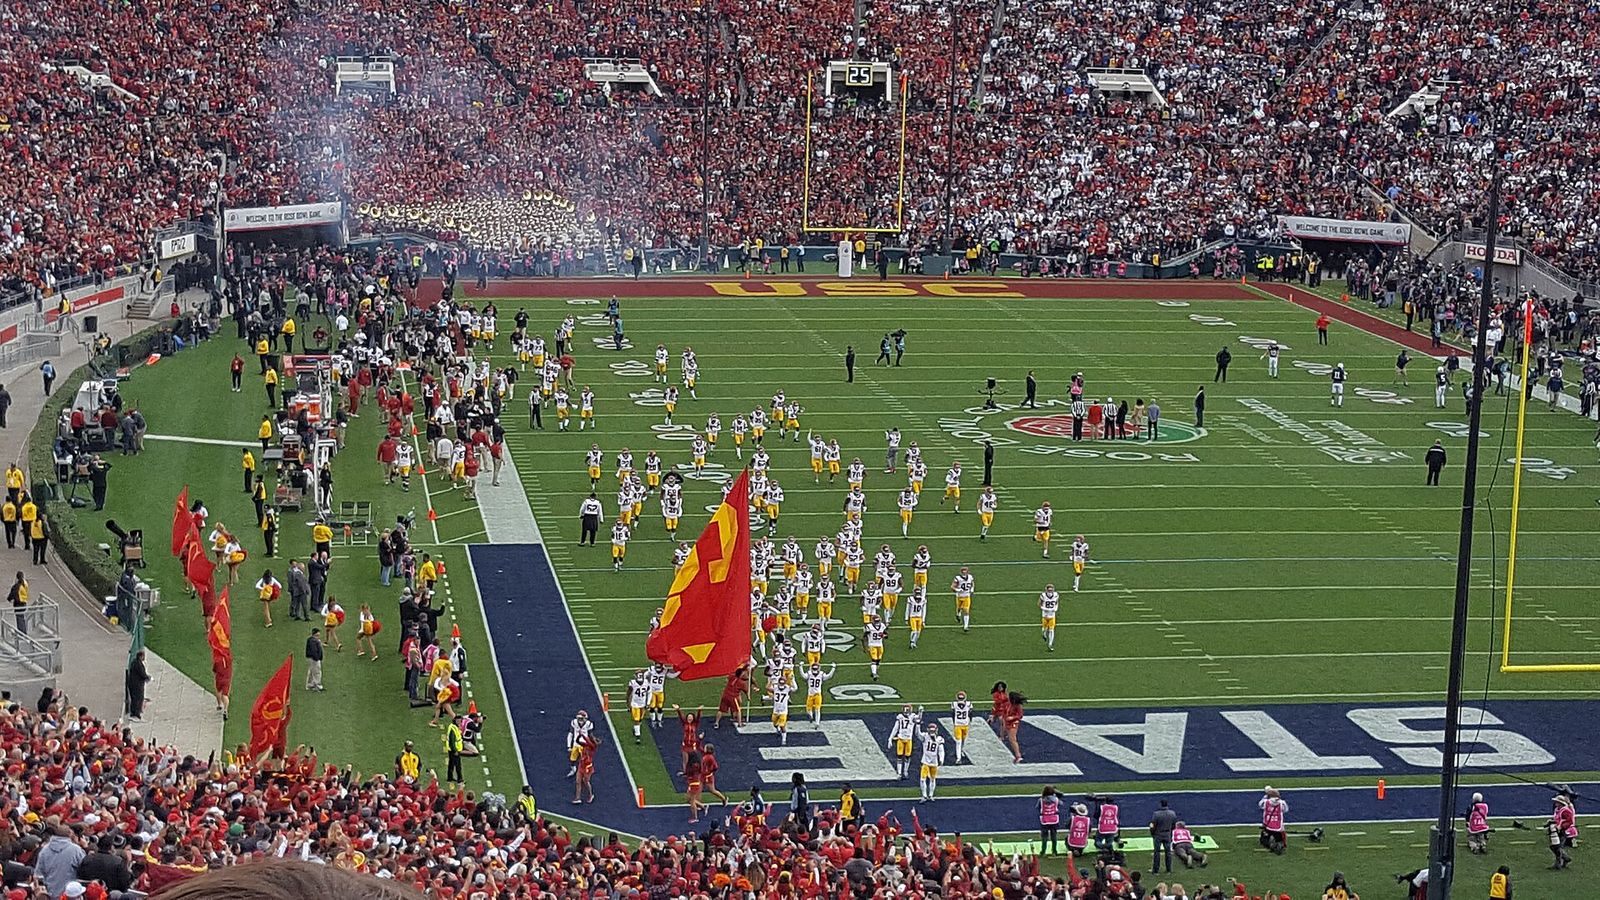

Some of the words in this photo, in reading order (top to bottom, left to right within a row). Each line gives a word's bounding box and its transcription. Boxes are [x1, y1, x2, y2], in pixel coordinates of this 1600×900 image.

[849, 67, 870, 83] 25
[1296, 223, 1320, 232] WELCOME
[1329, 226, 1338, 234] THE
[1369, 228, 1384, 237] GAME
[1467, 245, 1516, 261] HODA
[704, 281, 1026, 297] USC
[937, 415, 1021, 446] BOWL
[1019, 444, 1200, 462] ROSE
[820, 550, 828, 558] 15
[885, 579, 896, 587] 89
[960, 582, 970, 590] 45
[912, 604, 921, 612] 10
[652, 675, 662, 684] 26
[809, 678, 820, 687] 38
[634, 687, 646, 696] 42
[774, 692, 786, 702] 37
[956, 710, 967, 719] 28
[901, 719, 909, 728] 17
[737, 706, 1556, 784] STATE
[927, 741, 936, 752] 18
